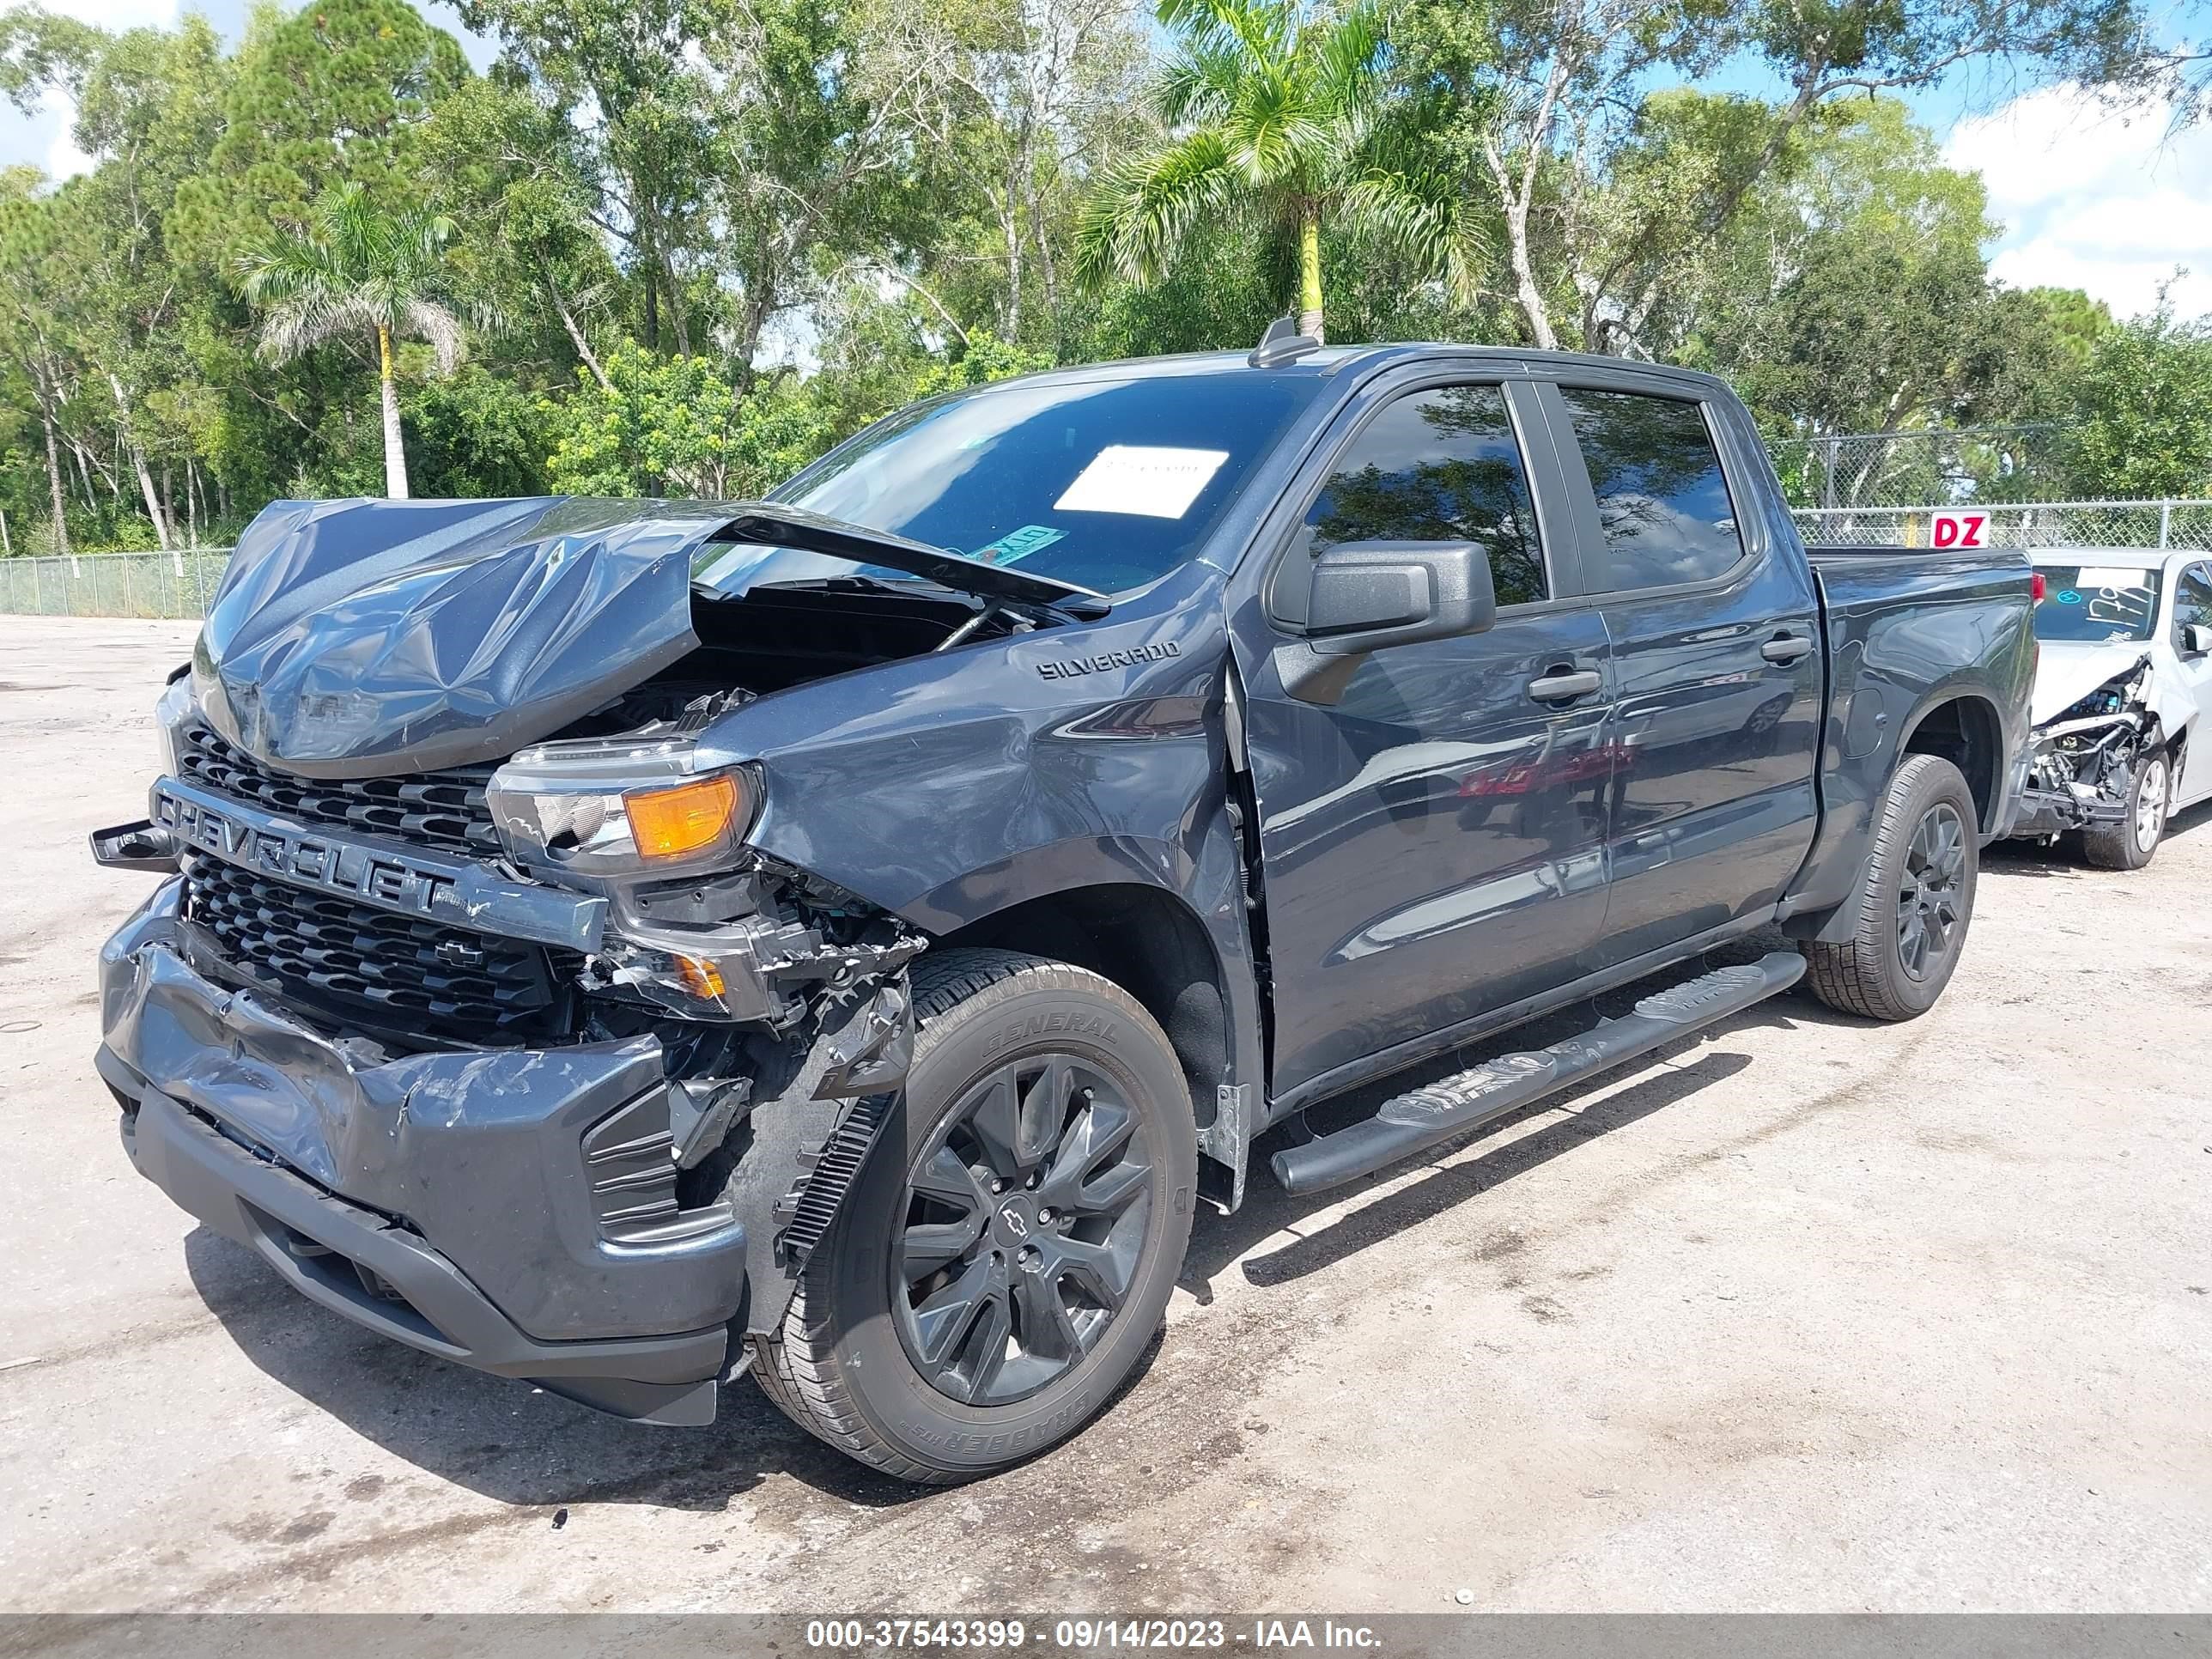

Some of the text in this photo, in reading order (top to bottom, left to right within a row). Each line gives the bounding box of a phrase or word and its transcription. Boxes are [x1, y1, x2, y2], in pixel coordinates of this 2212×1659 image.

[1934, 516, 1986, 548] DZ
[1036, 641, 1182, 681] SILVERADO
[155, 792, 459, 913] CHEVROLET
[982, 1012, 1119, 1058] GENERAL
[943, 1389, 1090, 1455] GRABBER
